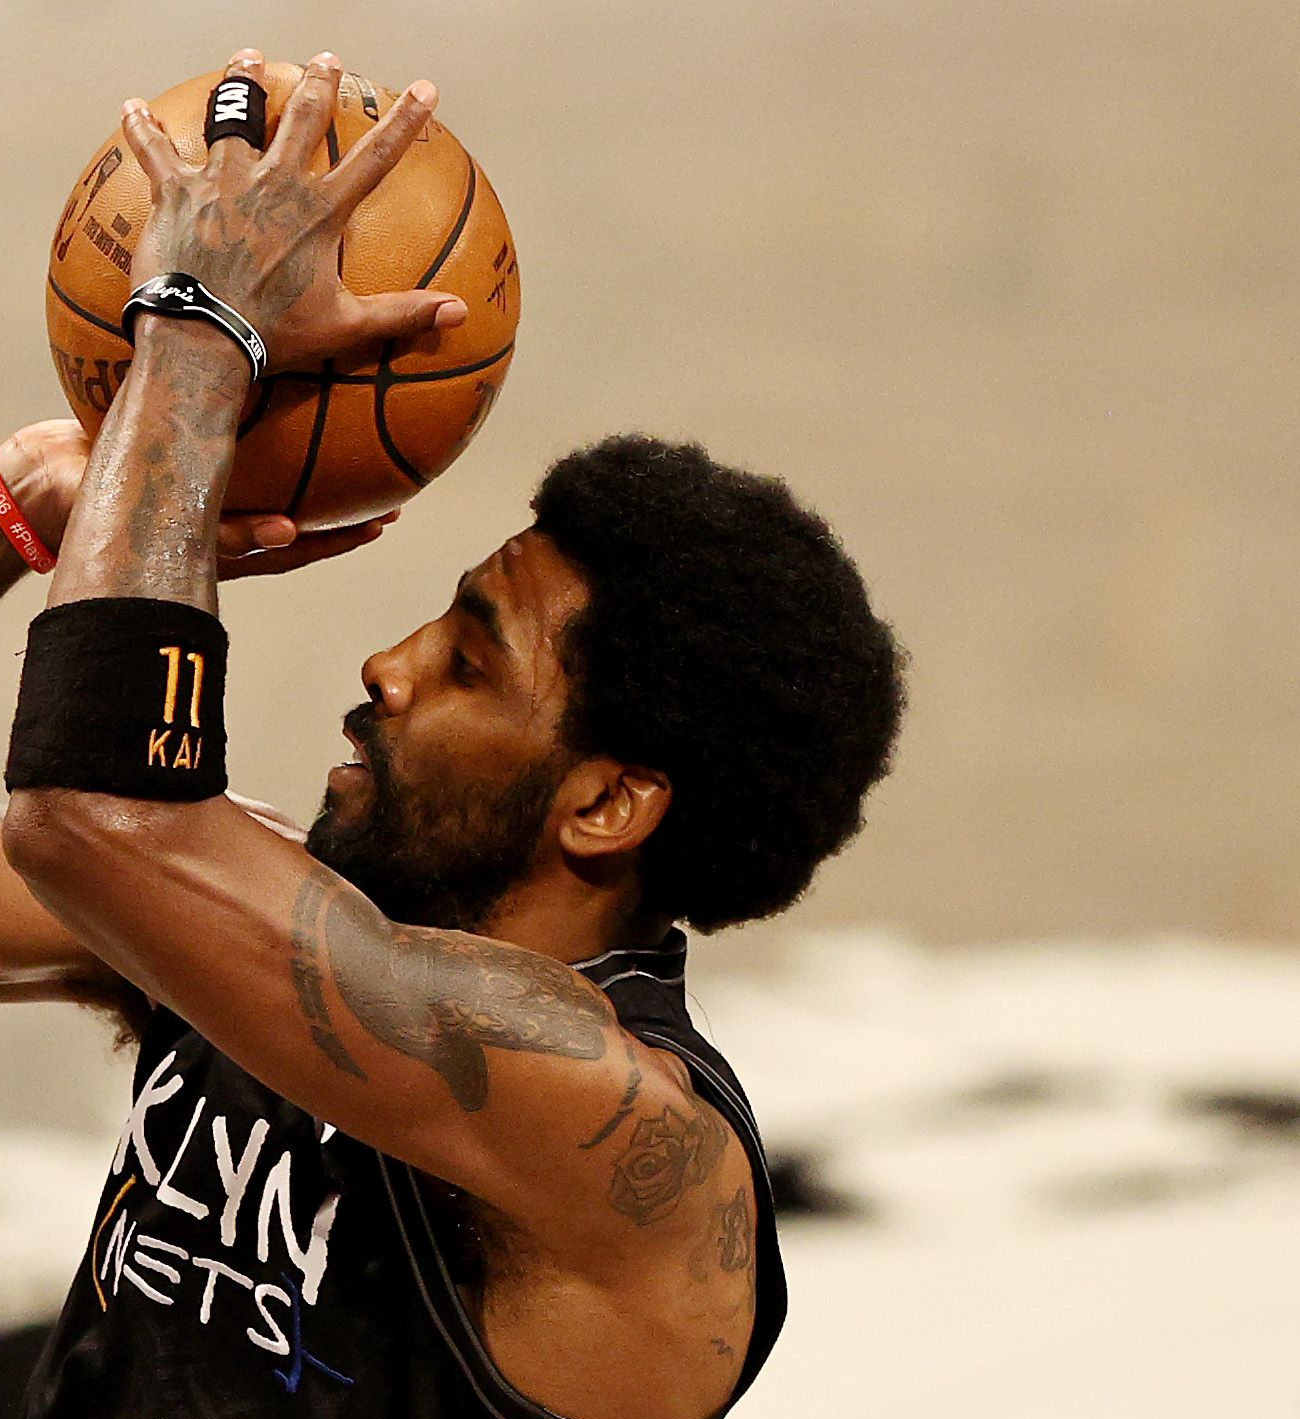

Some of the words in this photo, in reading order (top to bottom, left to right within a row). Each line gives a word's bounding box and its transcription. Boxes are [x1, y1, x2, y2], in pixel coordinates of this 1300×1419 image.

[214, 82, 249, 123] KAI
[159, 646, 205, 729] 11
[148, 728, 203, 770] KAI
[100, 1209, 291, 1355] NETS
